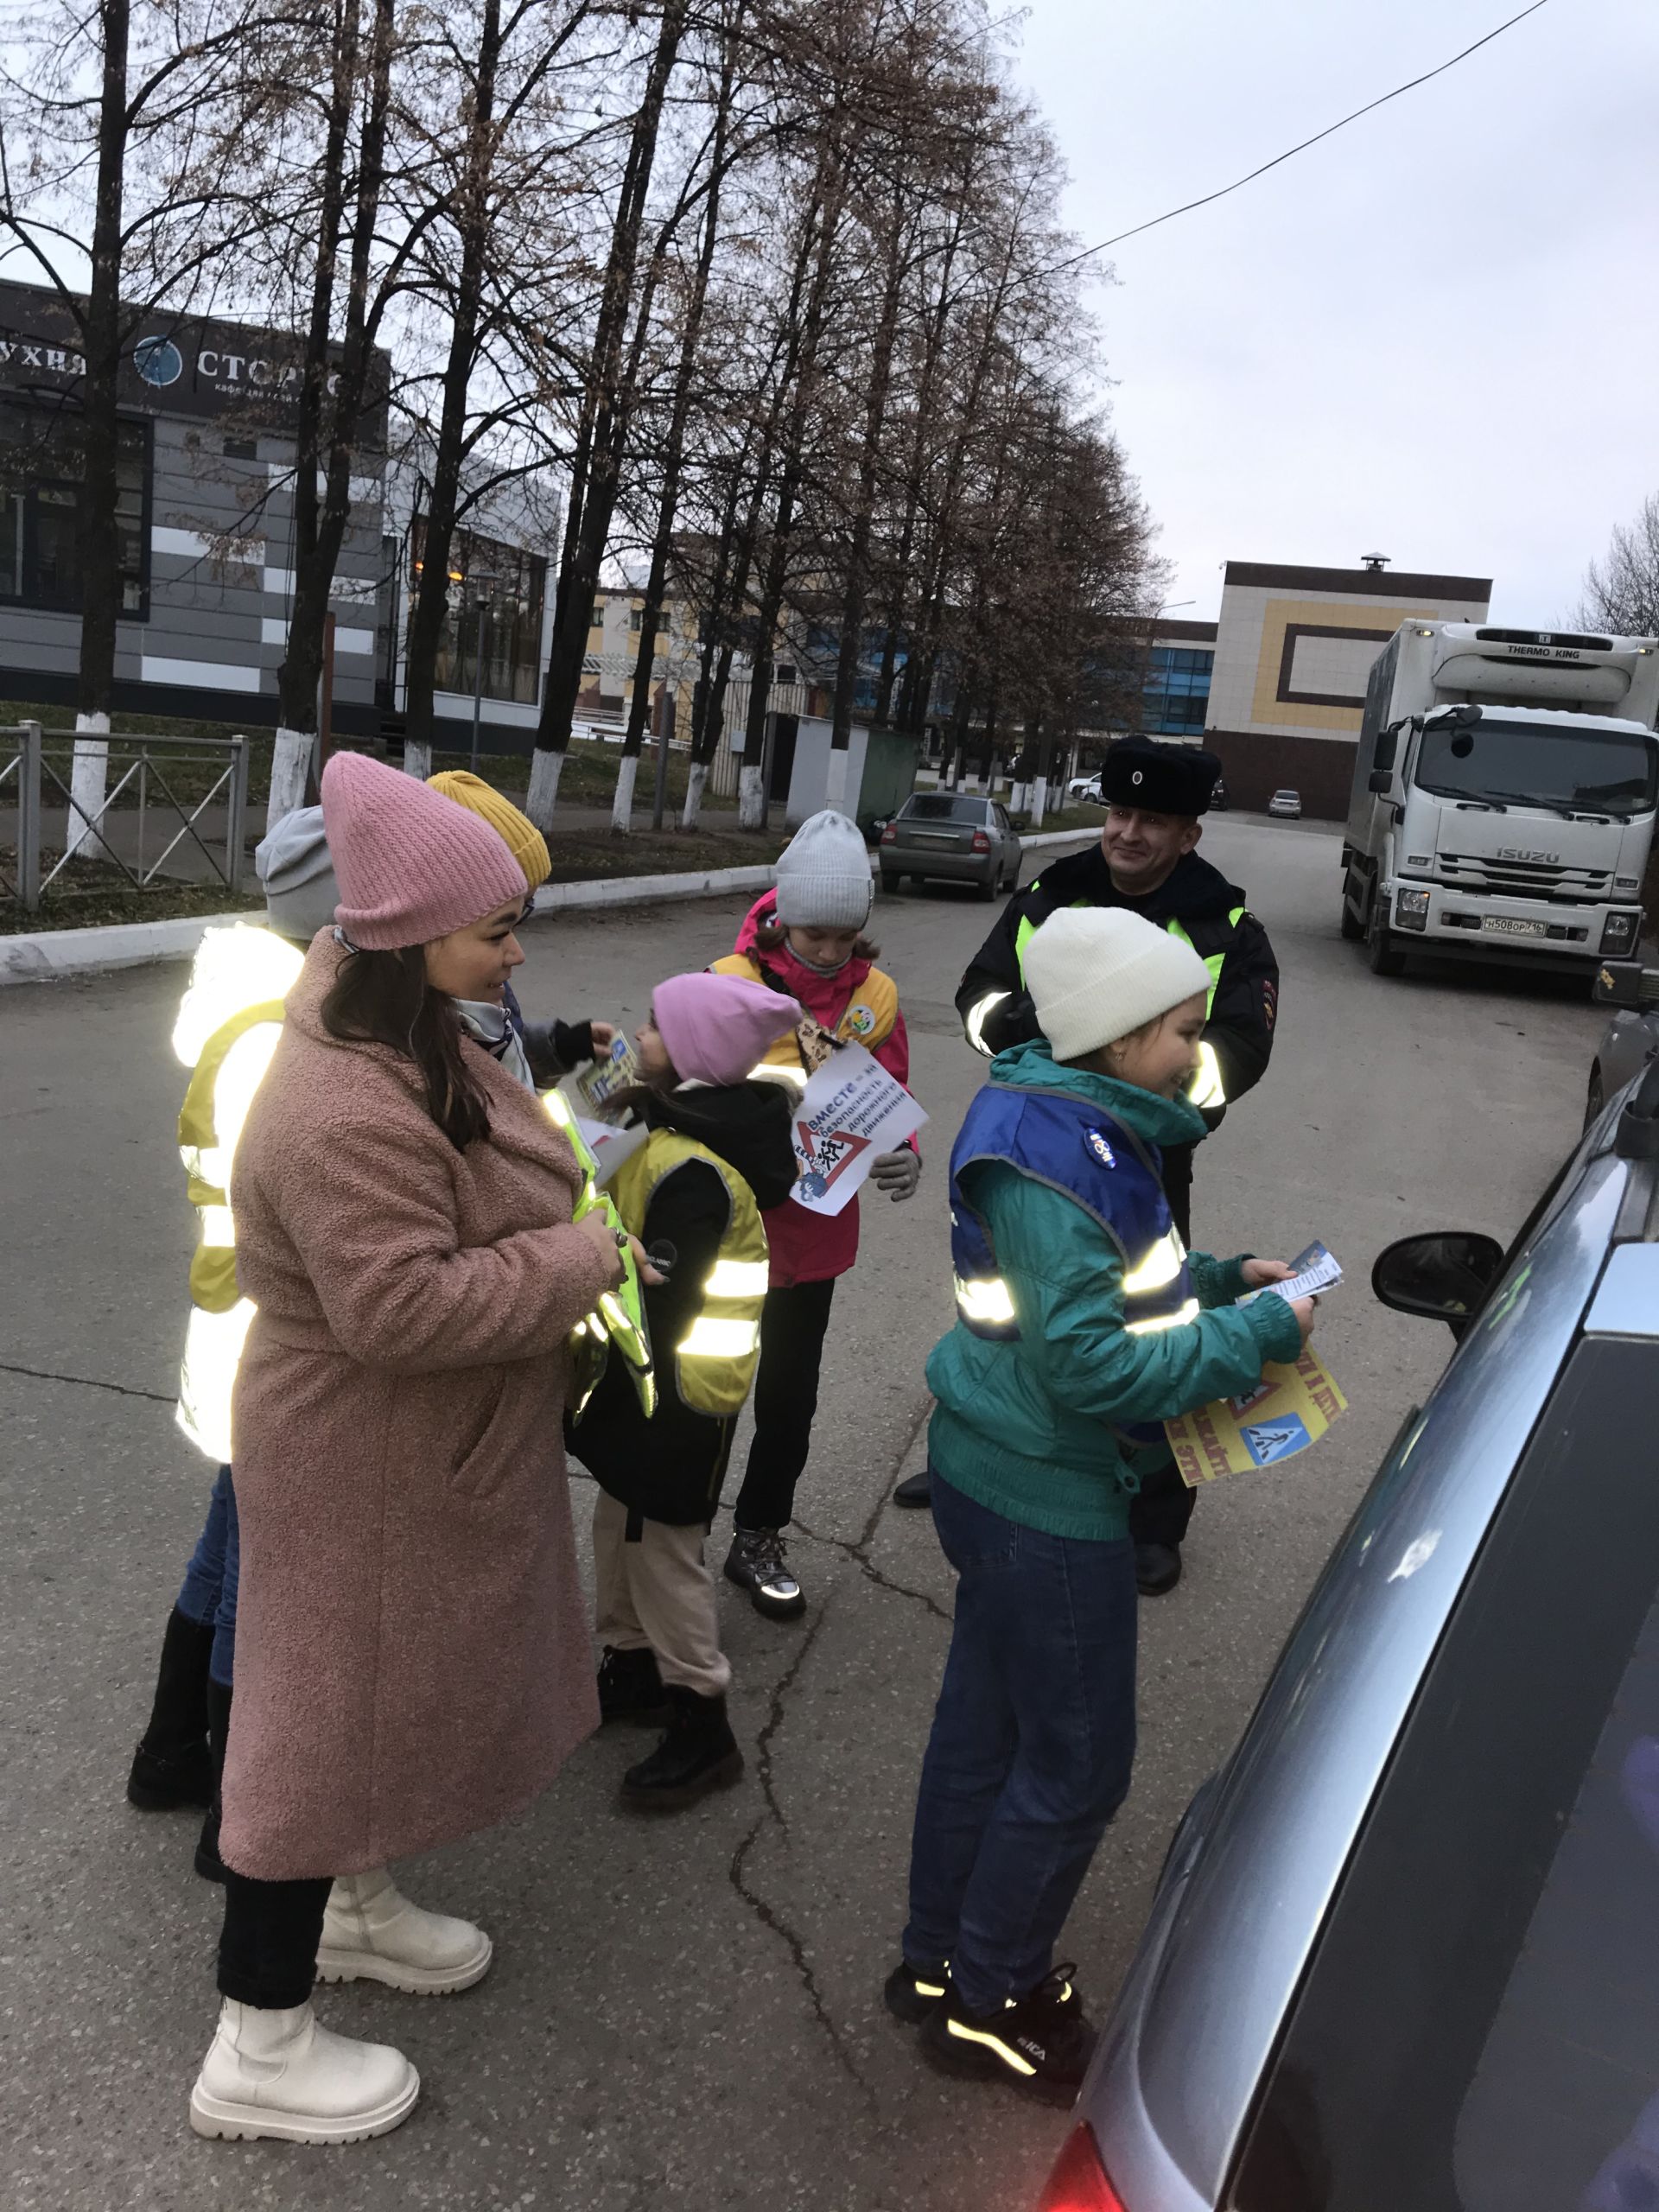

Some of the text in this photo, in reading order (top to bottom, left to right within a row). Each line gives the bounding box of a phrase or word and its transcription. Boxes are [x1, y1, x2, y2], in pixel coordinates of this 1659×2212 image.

[1508, 645, 1580, 658] THERMO KING
[1497, 847, 1560, 863] ISUZU
[819, 1079, 882, 1138] безопасность
[848, 1082, 897, 1132] дорожного
[862, 1091, 907, 1137] движения
